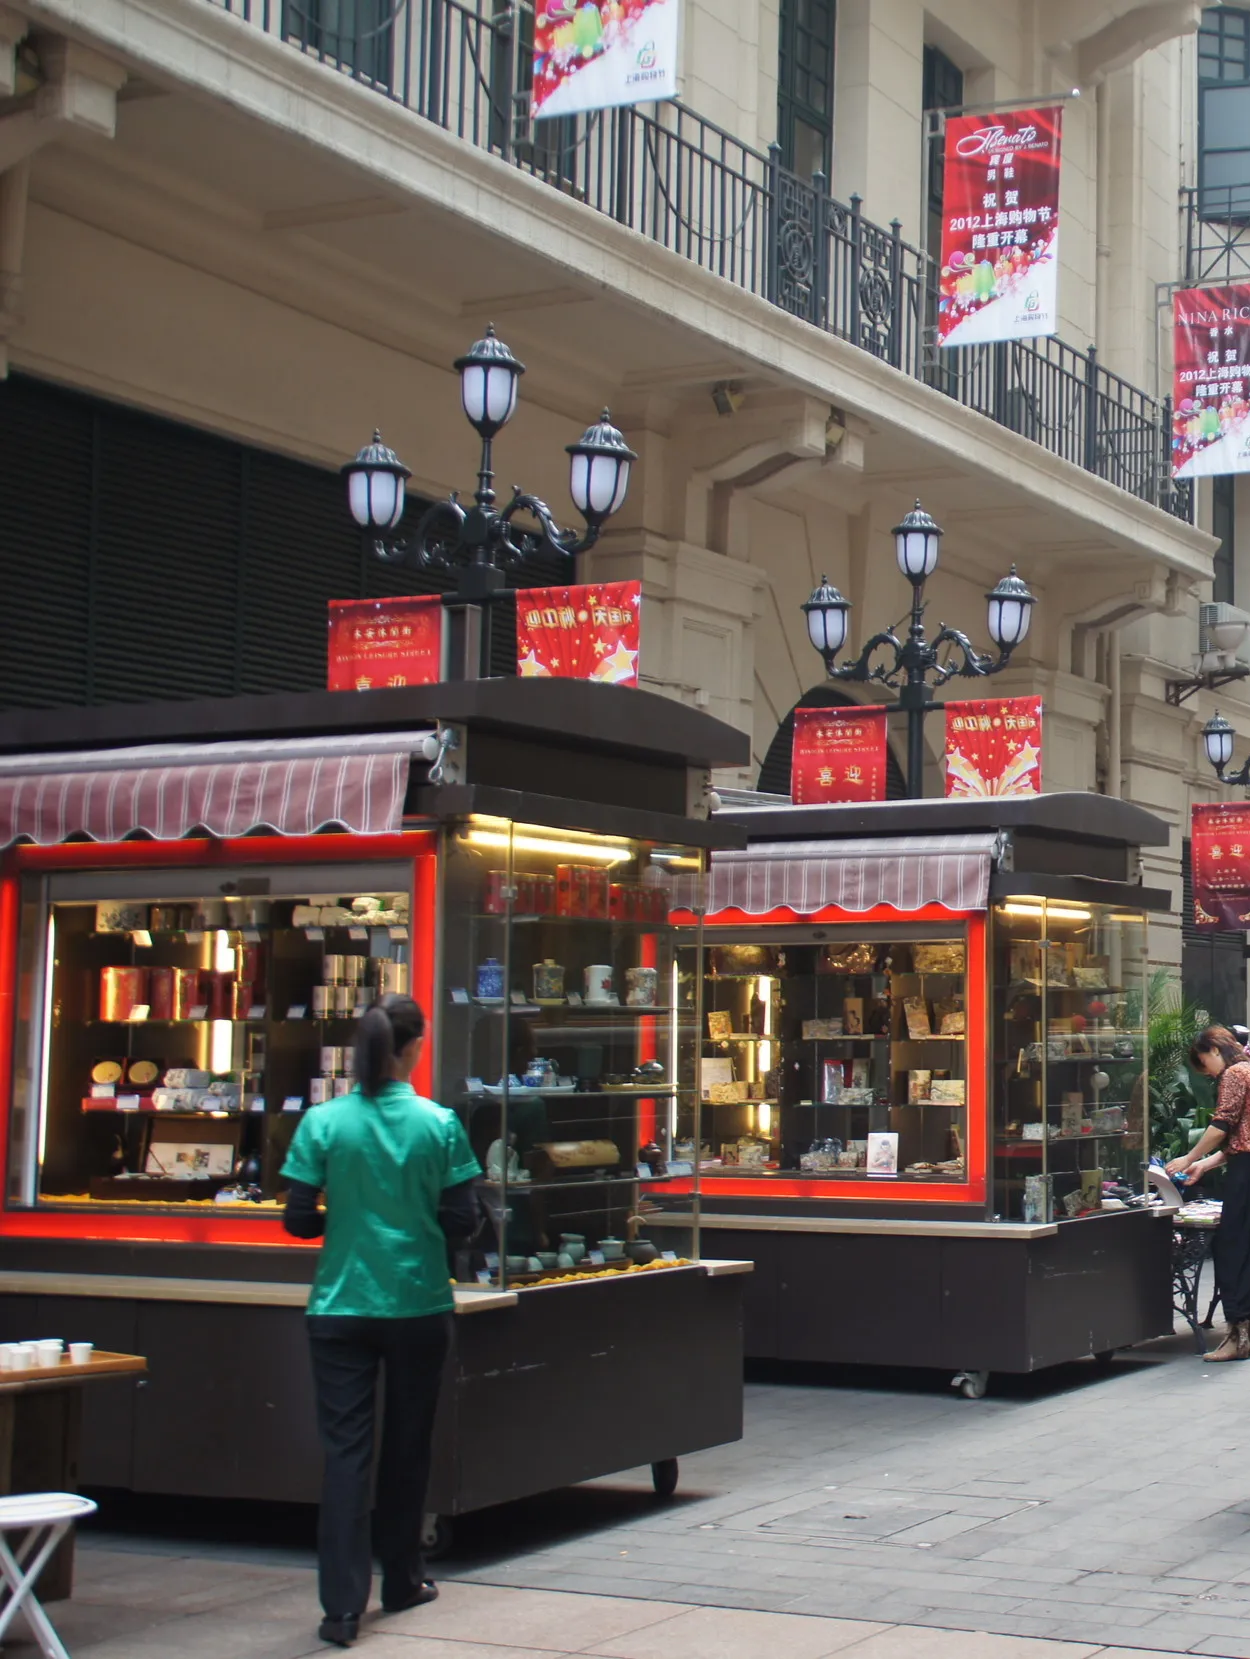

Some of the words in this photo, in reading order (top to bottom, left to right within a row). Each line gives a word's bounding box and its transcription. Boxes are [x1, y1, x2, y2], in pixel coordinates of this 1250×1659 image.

[983, 190, 1019, 209] 祝贺
[950, 206, 1052, 231] 2012上海购物节
[972, 228, 1028, 249] 隆重开幕
[1178, 311, 1218, 326] NINA
[1207, 349, 1237, 363] 祝贺
[1195, 380, 1243, 397] 隆重开幕
[815, 765, 865, 787] 喜迎
